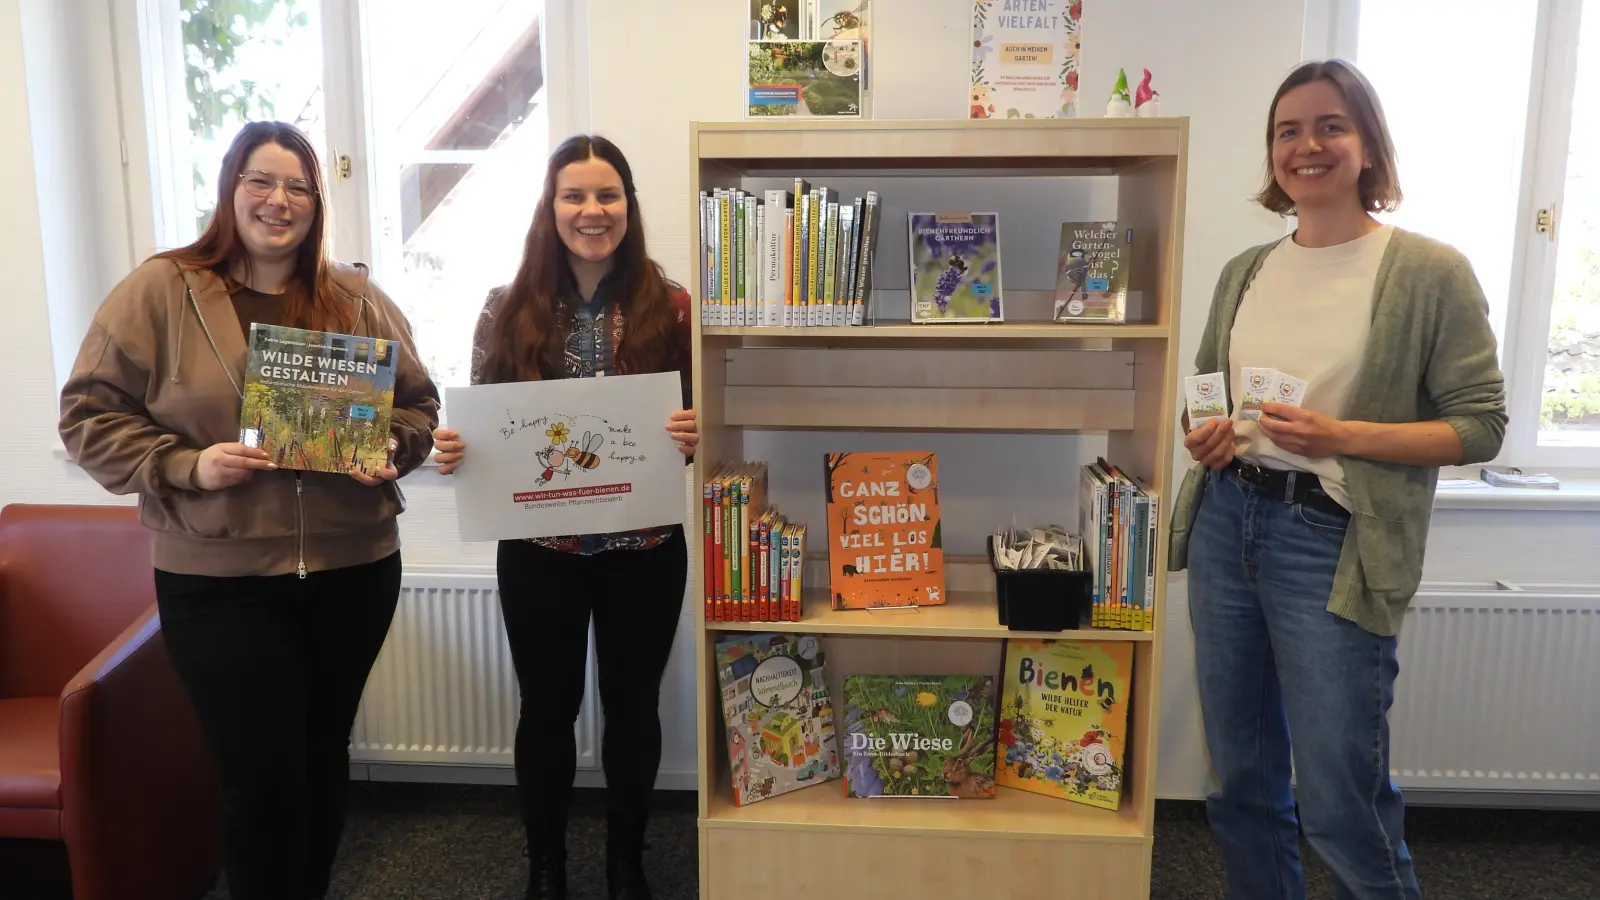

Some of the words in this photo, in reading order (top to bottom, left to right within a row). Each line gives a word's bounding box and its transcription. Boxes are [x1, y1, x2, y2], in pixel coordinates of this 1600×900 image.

[1003, 0, 1053, 11] ARTEN-
[998, 16, 1058, 29] VIELFALT
[918, 227, 990, 235] BIENENFREUNDLICH
[1073, 229, 1118, 239] Welcher
[861, 235, 870, 265] gestalten
[1072, 240, 1115, 250] Garten-
[769, 231, 777, 281] Permakultur
[1091, 248, 1120, 261] vogel
[1090, 259, 1104, 268] ist
[858, 264, 866, 288] Wiesen
[262, 350, 313, 367] WILDE
[318, 357, 377, 375] WIESEN
[260, 365, 349, 386] GESTALTEN
[500, 427, 516, 440] Be
[520, 415, 549, 431] happy
[608, 425, 632, 434] make
[622, 437, 636, 447] bee
[608, 452, 637, 465] happy
[514, 484, 631, 501] www.wir-tun-was-fuer-bienen.de
[840, 481, 900, 498] GANZ
[524, 499, 567, 510] Bundesweiter
[568, 495, 623, 506] Pflanzwettbewerb
[853, 503, 926, 526] SCHÖN
[839, 533, 885, 549] VIEL
[893, 530, 928, 546] LOS
[855, 551, 929, 573] HIER!
[755, 668, 798, 684] NACHHALTIGKEIT
[1018, 657, 1115, 699] Bienen
[757, 680, 799, 696] Wimmelbuch
[1041, 692, 1062, 704] WILDE
[1064, 697, 1089, 708] HELFER
[1045, 704, 1058, 713] DER
[1060, 707, 1083, 717] NATUR
[850, 732, 886, 750] Die
[888, 732, 953, 750] Wiese
